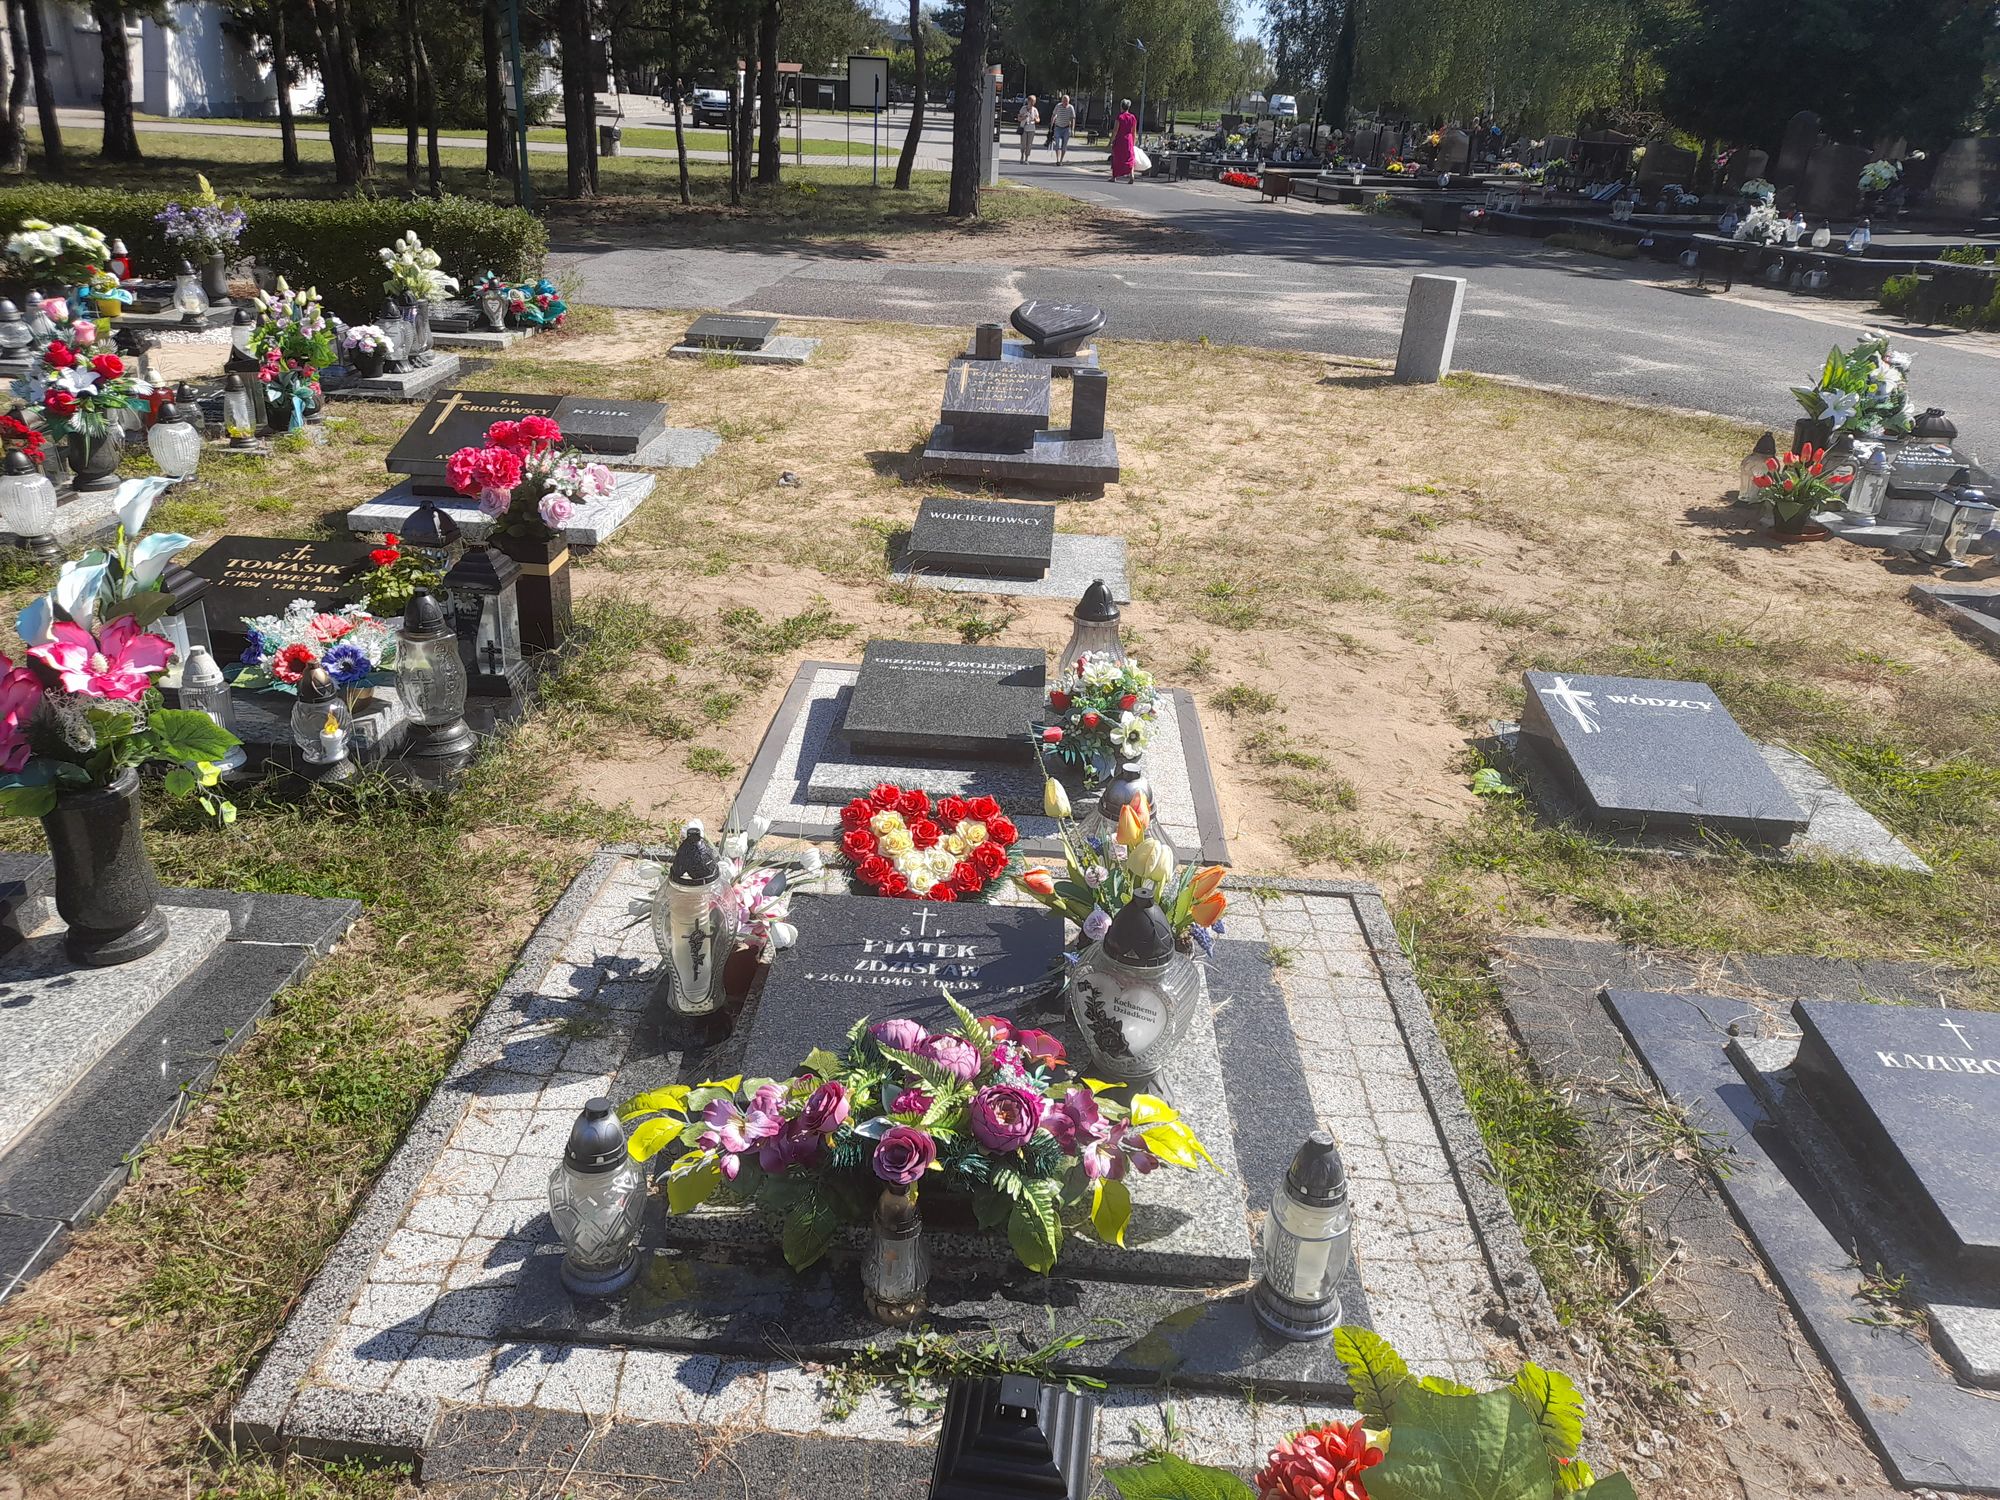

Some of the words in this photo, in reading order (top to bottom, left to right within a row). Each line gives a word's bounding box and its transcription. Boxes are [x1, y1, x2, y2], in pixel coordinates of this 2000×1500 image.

[460, 404, 552, 416] SROKOWSCY
[930, 511, 1042, 526] WOJCIECHOWSCY
[226, 558, 345, 575] TOMASIK
[223, 570, 322, 583] GENOWEFA
[854, 959, 982, 978] ZDZISŁAW
[1113, 1005, 1156, 1024] Dziadkowi
[1114, 996, 1157, 1017] Kochanemu
